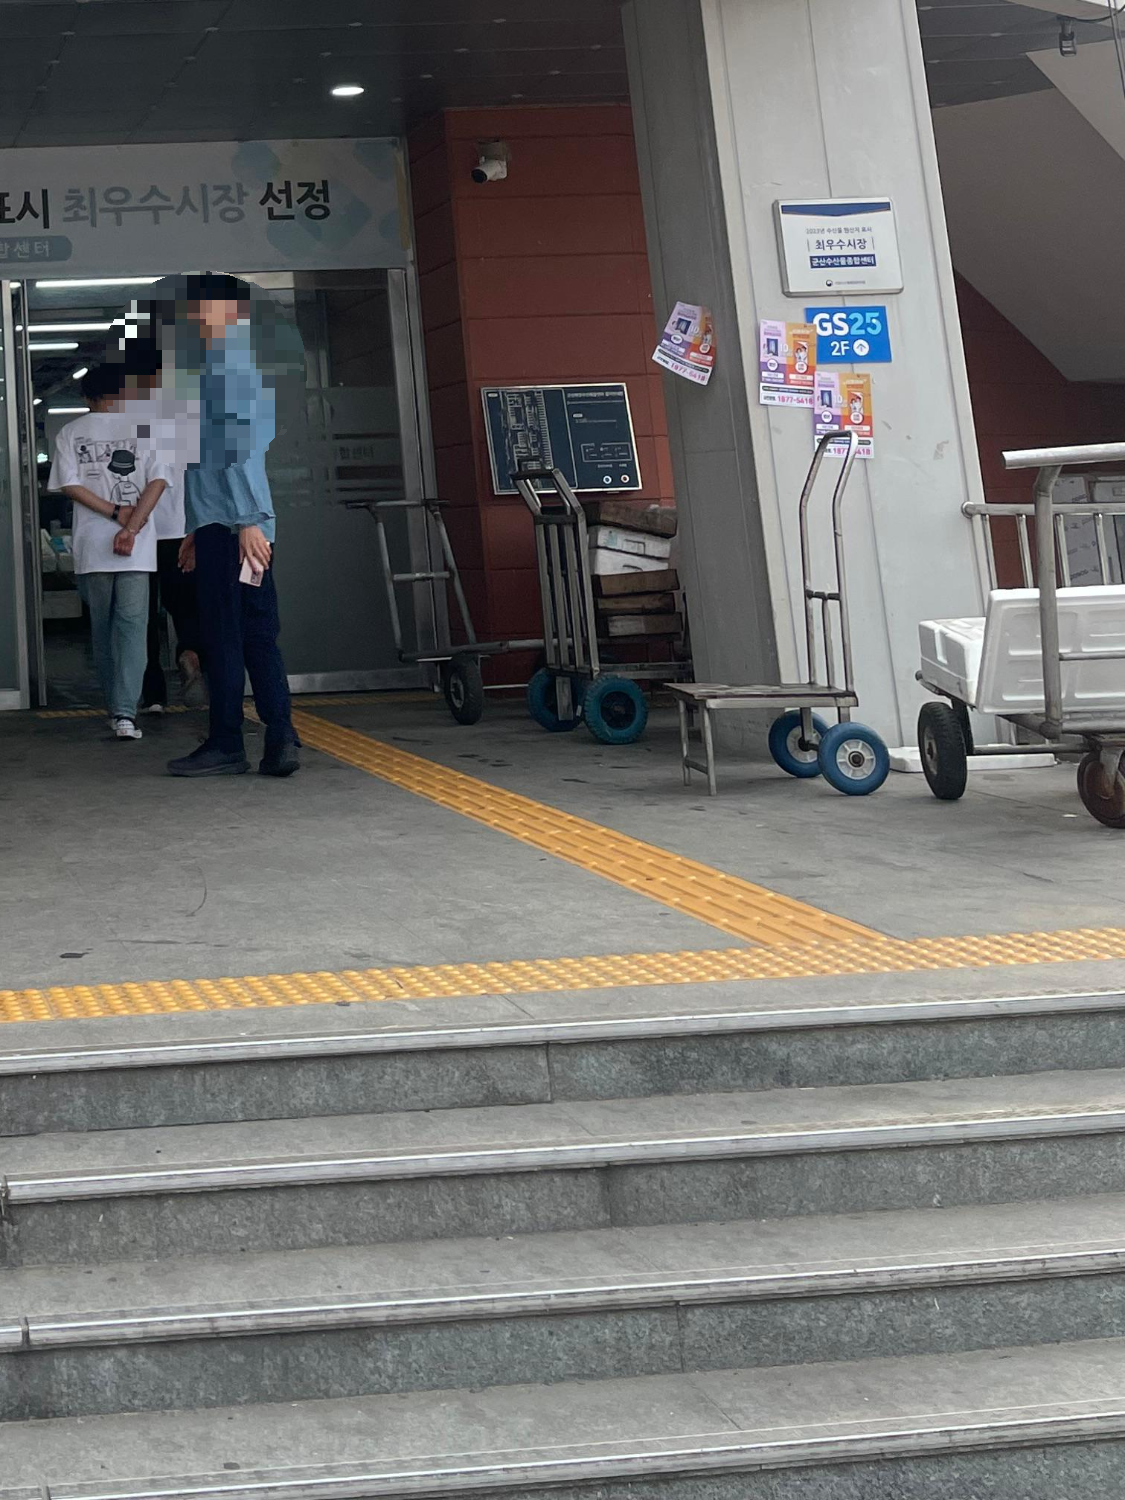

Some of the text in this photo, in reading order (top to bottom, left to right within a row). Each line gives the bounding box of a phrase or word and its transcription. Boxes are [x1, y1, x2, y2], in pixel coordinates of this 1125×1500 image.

[62, 182, 249, 228] 최우수시장
[259, 179, 331, 221] 선정
[815, 238, 867, 251] 최우수시장
[811, 255, 875, 267] 군산수산물종합센터
[813, 312, 882, 336] GS25
[830, 341, 850, 356] 2F
